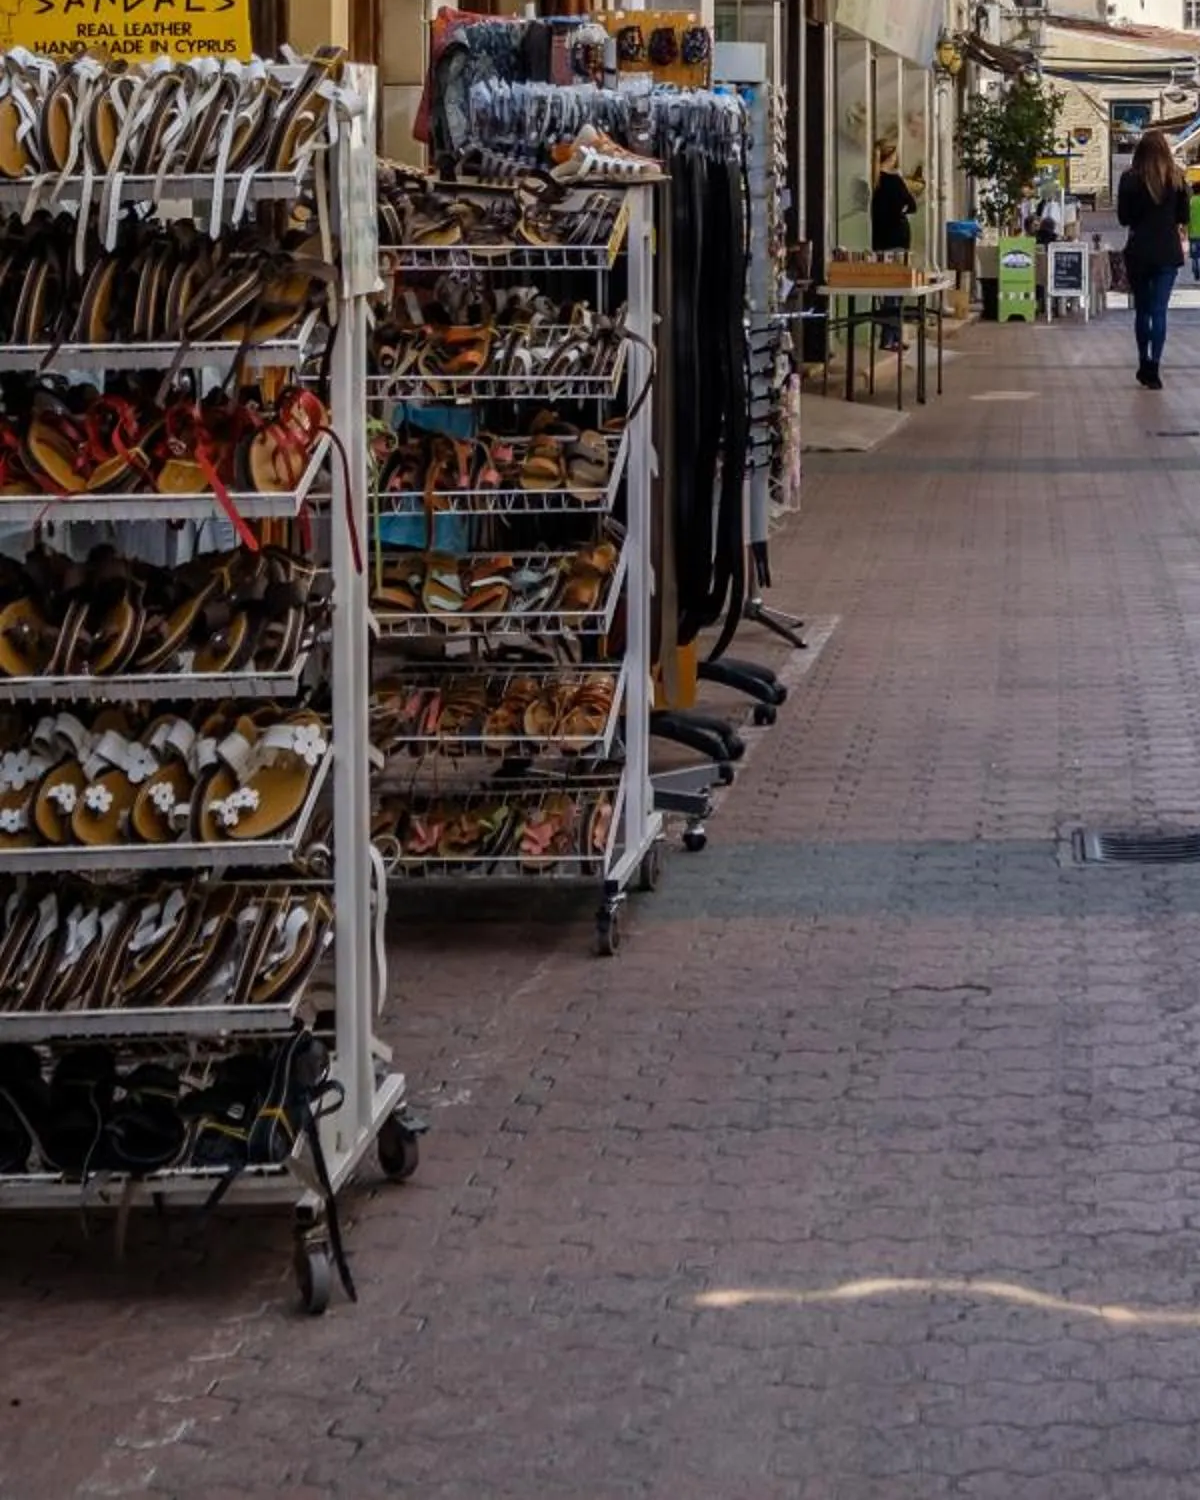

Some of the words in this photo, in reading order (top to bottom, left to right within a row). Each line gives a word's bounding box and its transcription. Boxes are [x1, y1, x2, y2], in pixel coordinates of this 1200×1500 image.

[76, 23, 118, 38] REAL
[123, 21, 192, 37] LEATHER
[151, 40, 169, 54] IN
[175, 39, 236, 54] CYPRUS
